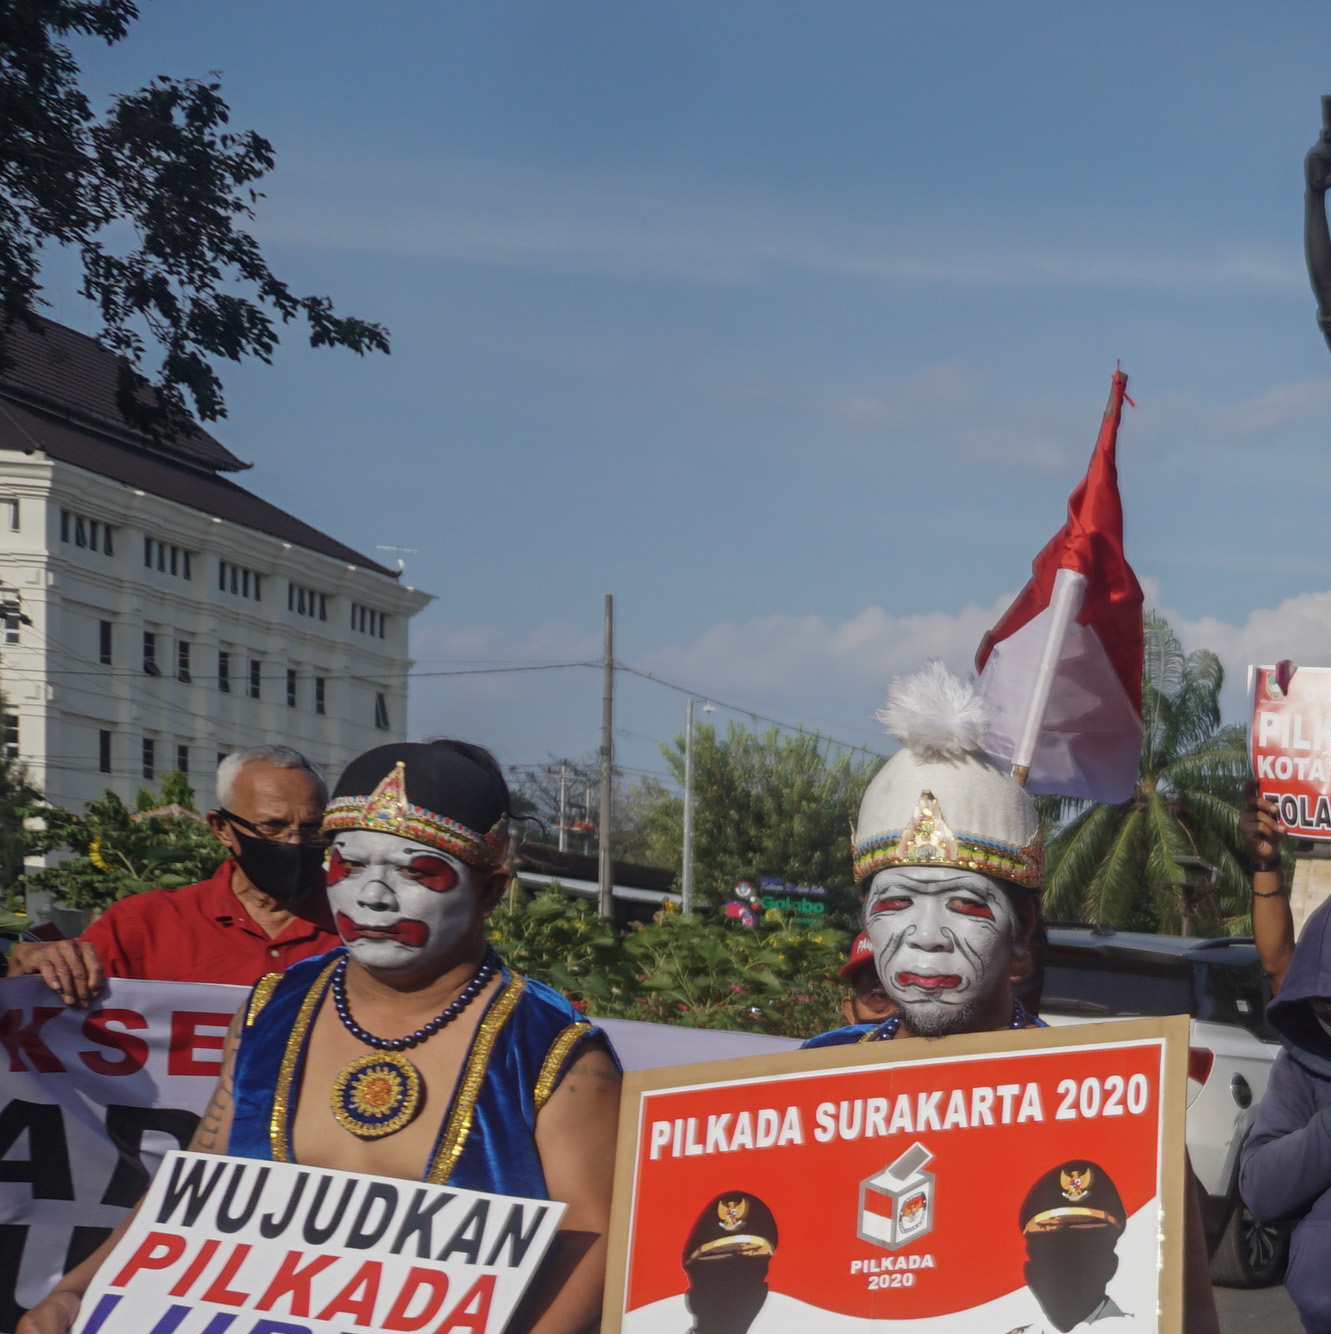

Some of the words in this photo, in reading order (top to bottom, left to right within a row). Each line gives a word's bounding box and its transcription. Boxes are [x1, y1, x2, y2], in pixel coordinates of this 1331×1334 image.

[1257, 754, 1327, 782] KOTA
[649, 1106, 802, 1160] PILKADA
[815, 1082, 1043, 1142] SURAKARTA
[1055, 1072, 1148, 1121] 2020
[155, 1156, 548, 1270] WUJUDKAN
[850, 1253, 935, 1275] PILKADA
[868, 1272, 914, 1291] 2020
